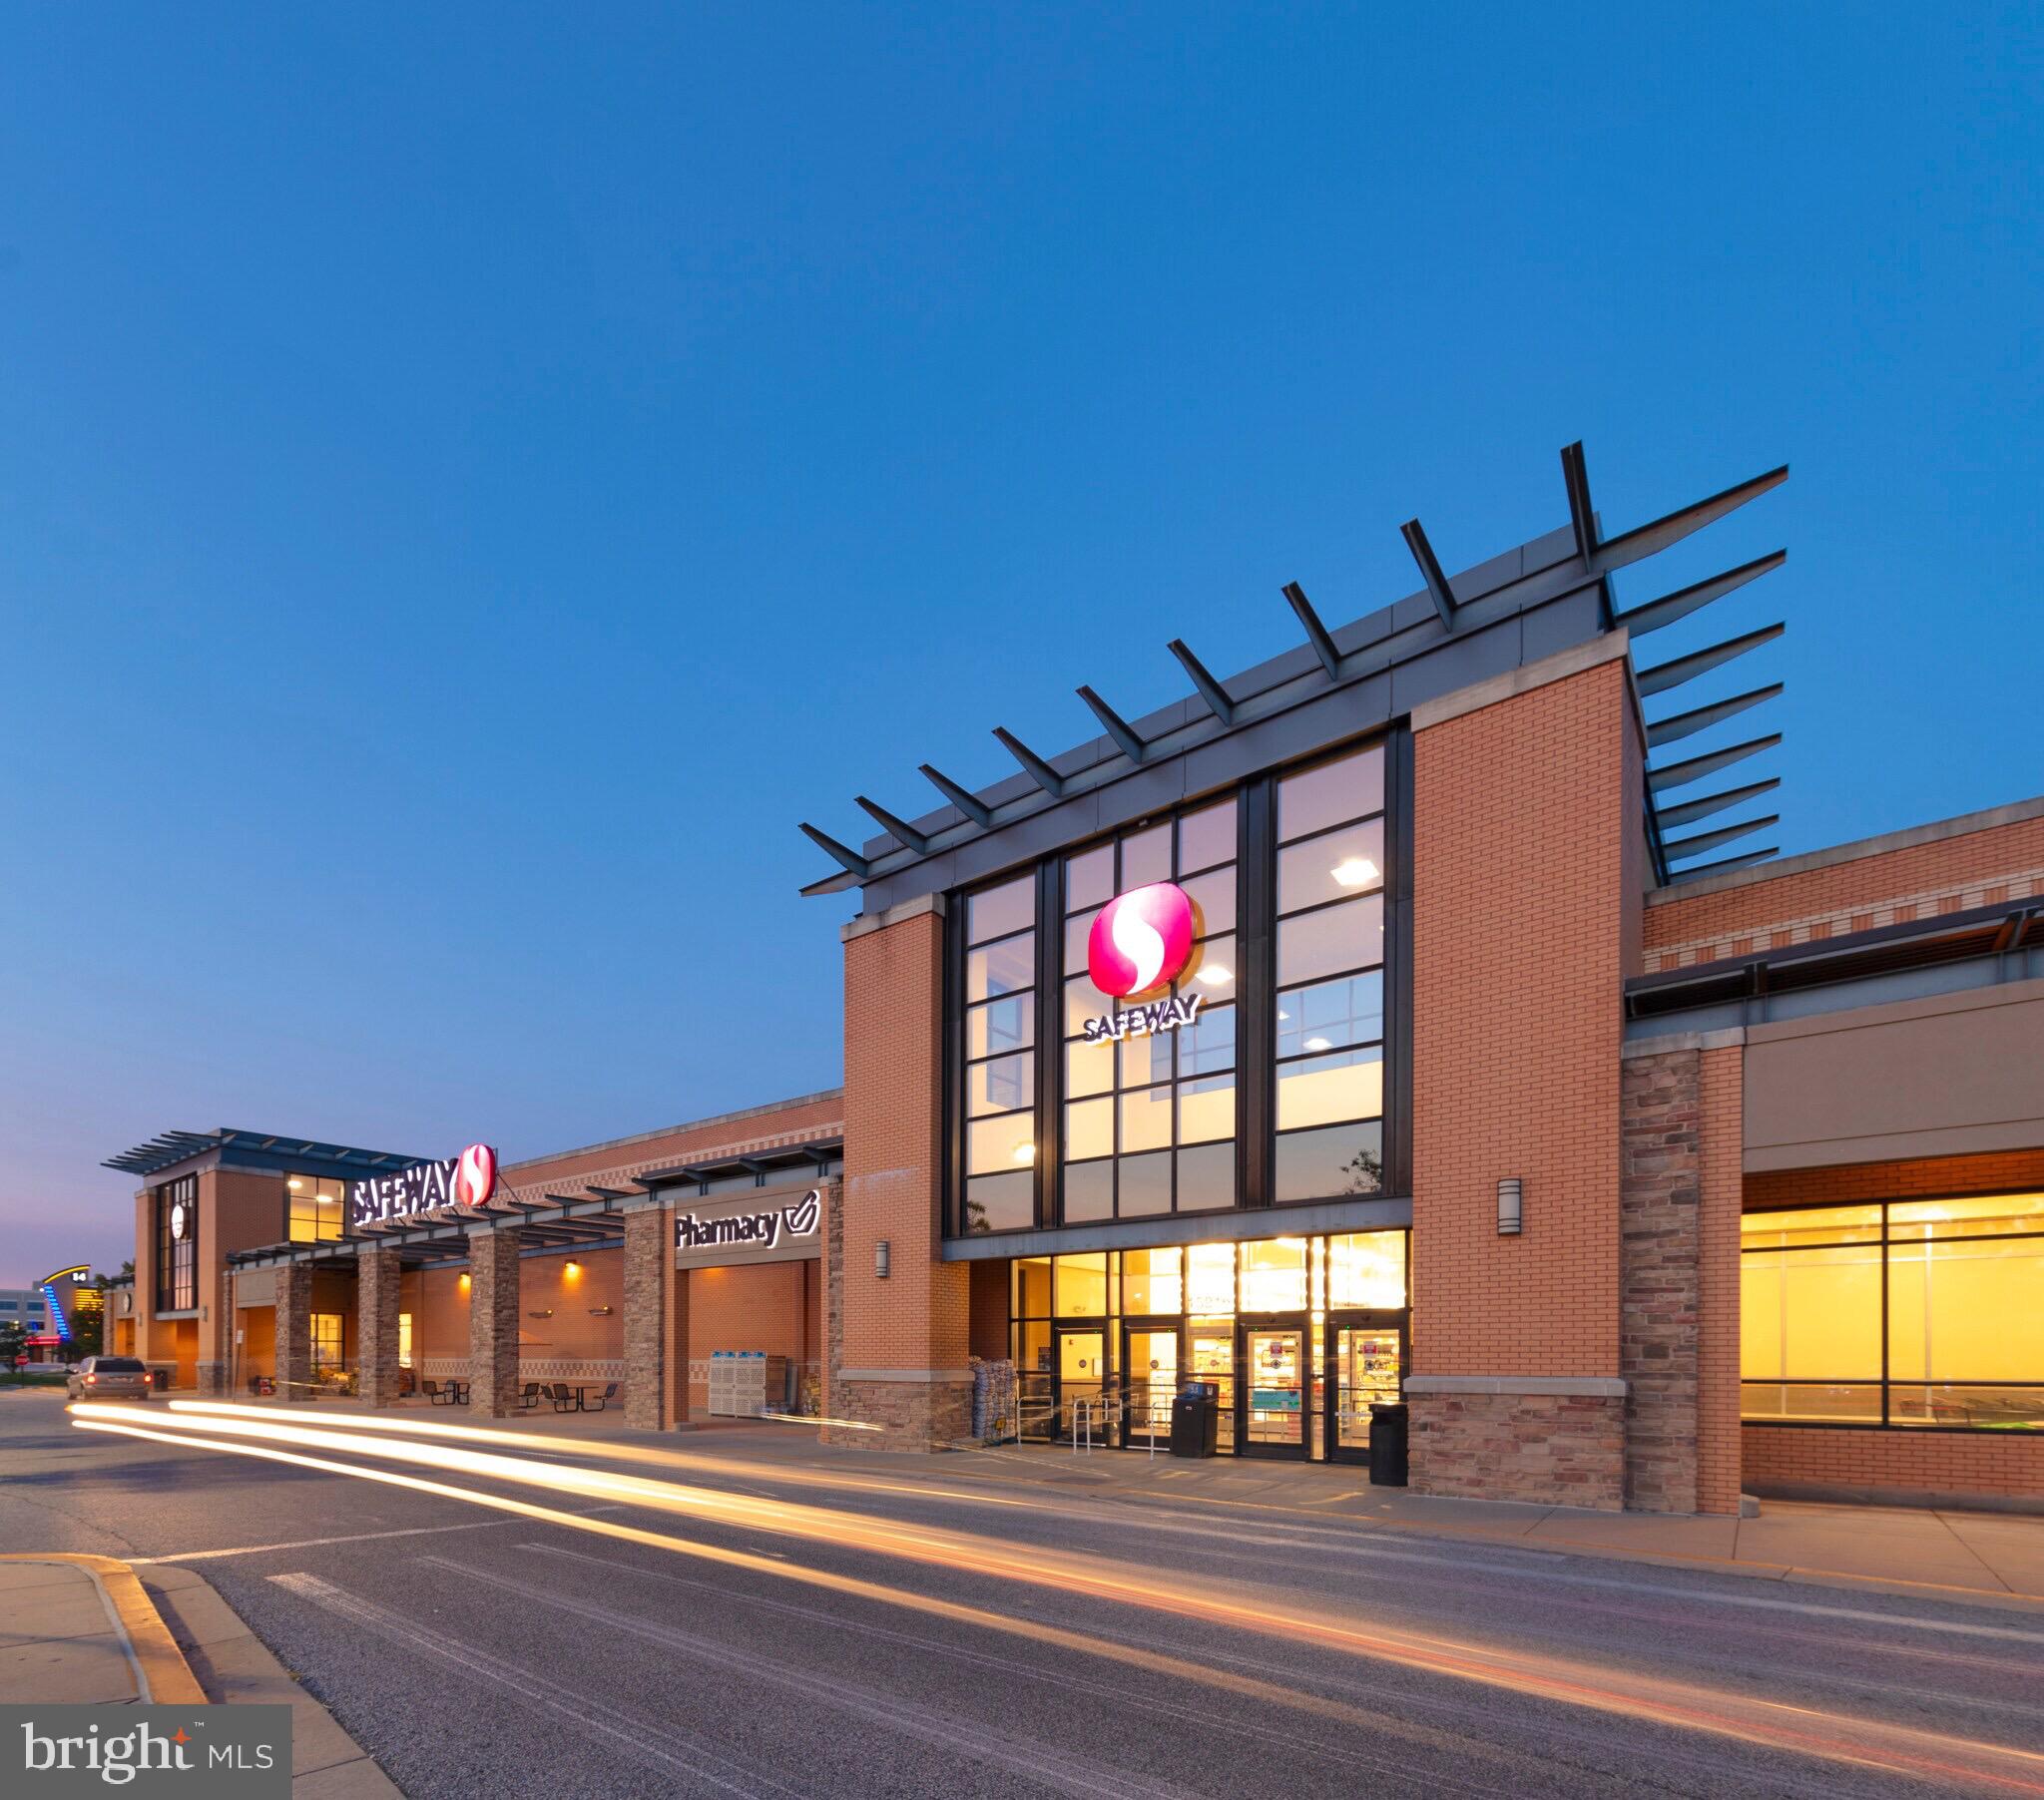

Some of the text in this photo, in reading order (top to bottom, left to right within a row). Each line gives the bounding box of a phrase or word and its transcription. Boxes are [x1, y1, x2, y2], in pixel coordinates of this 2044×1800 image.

[1083, 994, 1202, 1046] SAFEWAY
[352, 1157, 458, 1226] SAFEWAY
[675, 1212, 781, 1249] Pharmacy
